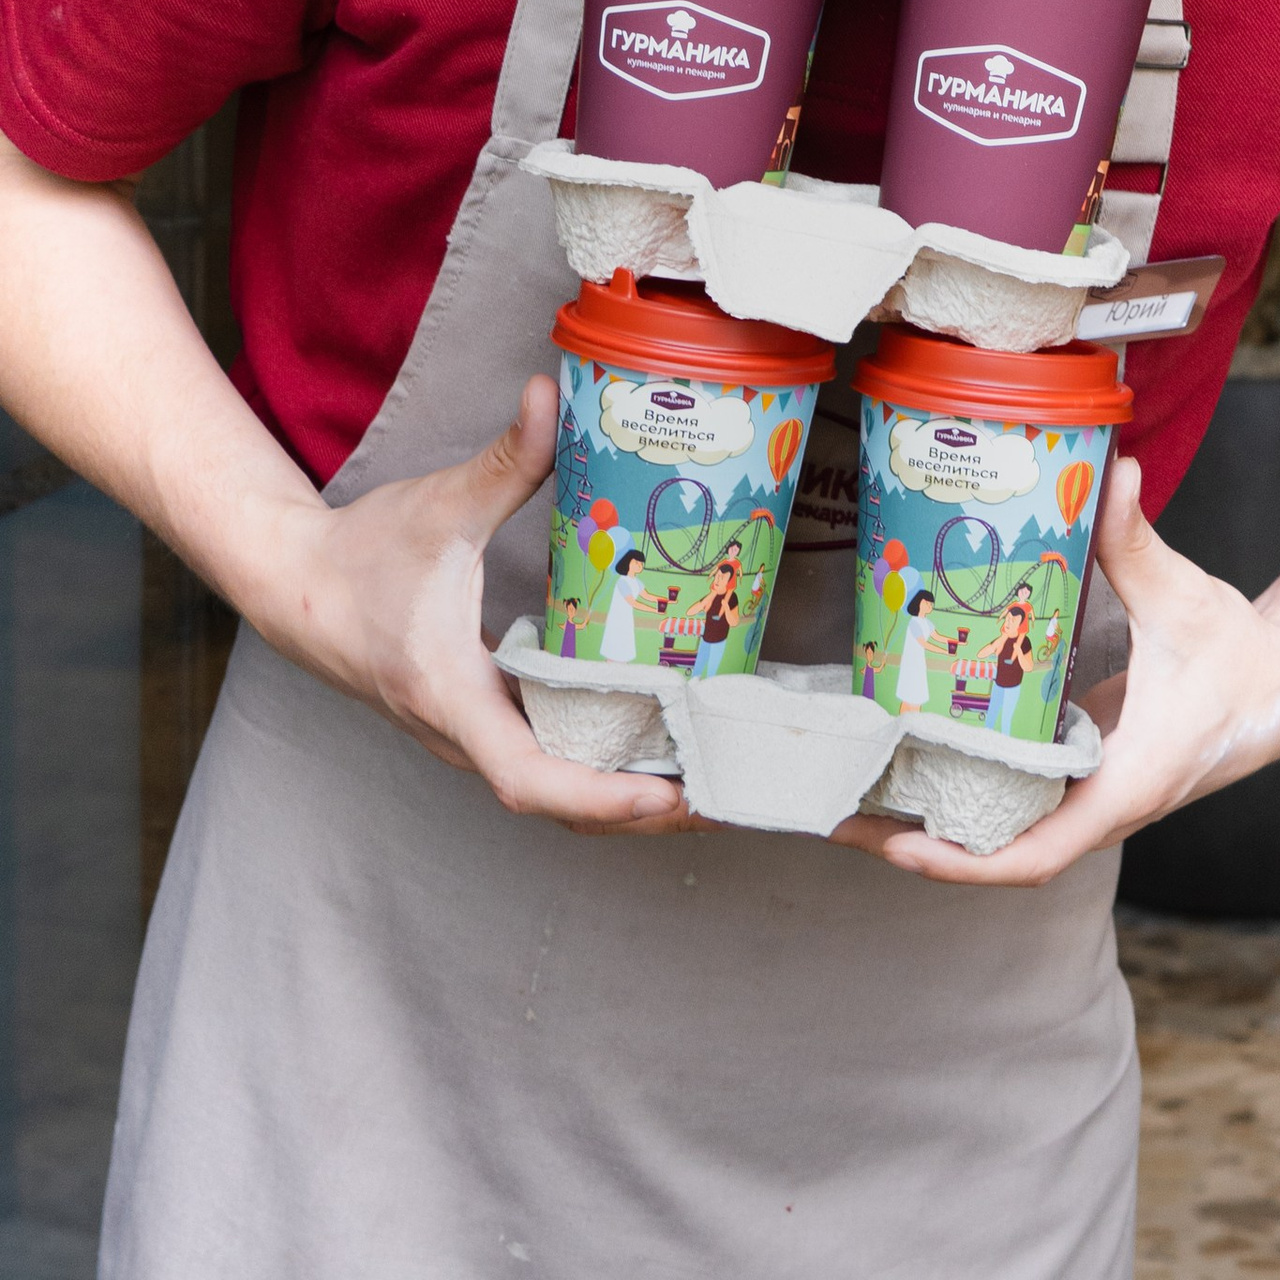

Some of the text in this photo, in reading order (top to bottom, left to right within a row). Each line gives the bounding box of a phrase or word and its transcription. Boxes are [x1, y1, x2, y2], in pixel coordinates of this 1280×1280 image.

[611, 28, 751, 69] ГУРМАНИКА
[627, 57, 675, 73] кулинария
[685, 67, 726, 80] пекарня
[927, 72, 1066, 118] ГУРМАНИКА
[943, 102, 991, 118] кулинария
[1001, 113, 1042, 127] пекарня
[1105, 294, 1168, 326] Юрий
[644, 409, 699, 428] Время
[621, 419, 715, 442] веселиться
[639, 436, 697, 452] вместе
[929, 446, 982, 465] Время
[908, 457, 999, 480] веселиться
[924, 474, 981, 491] вместе
